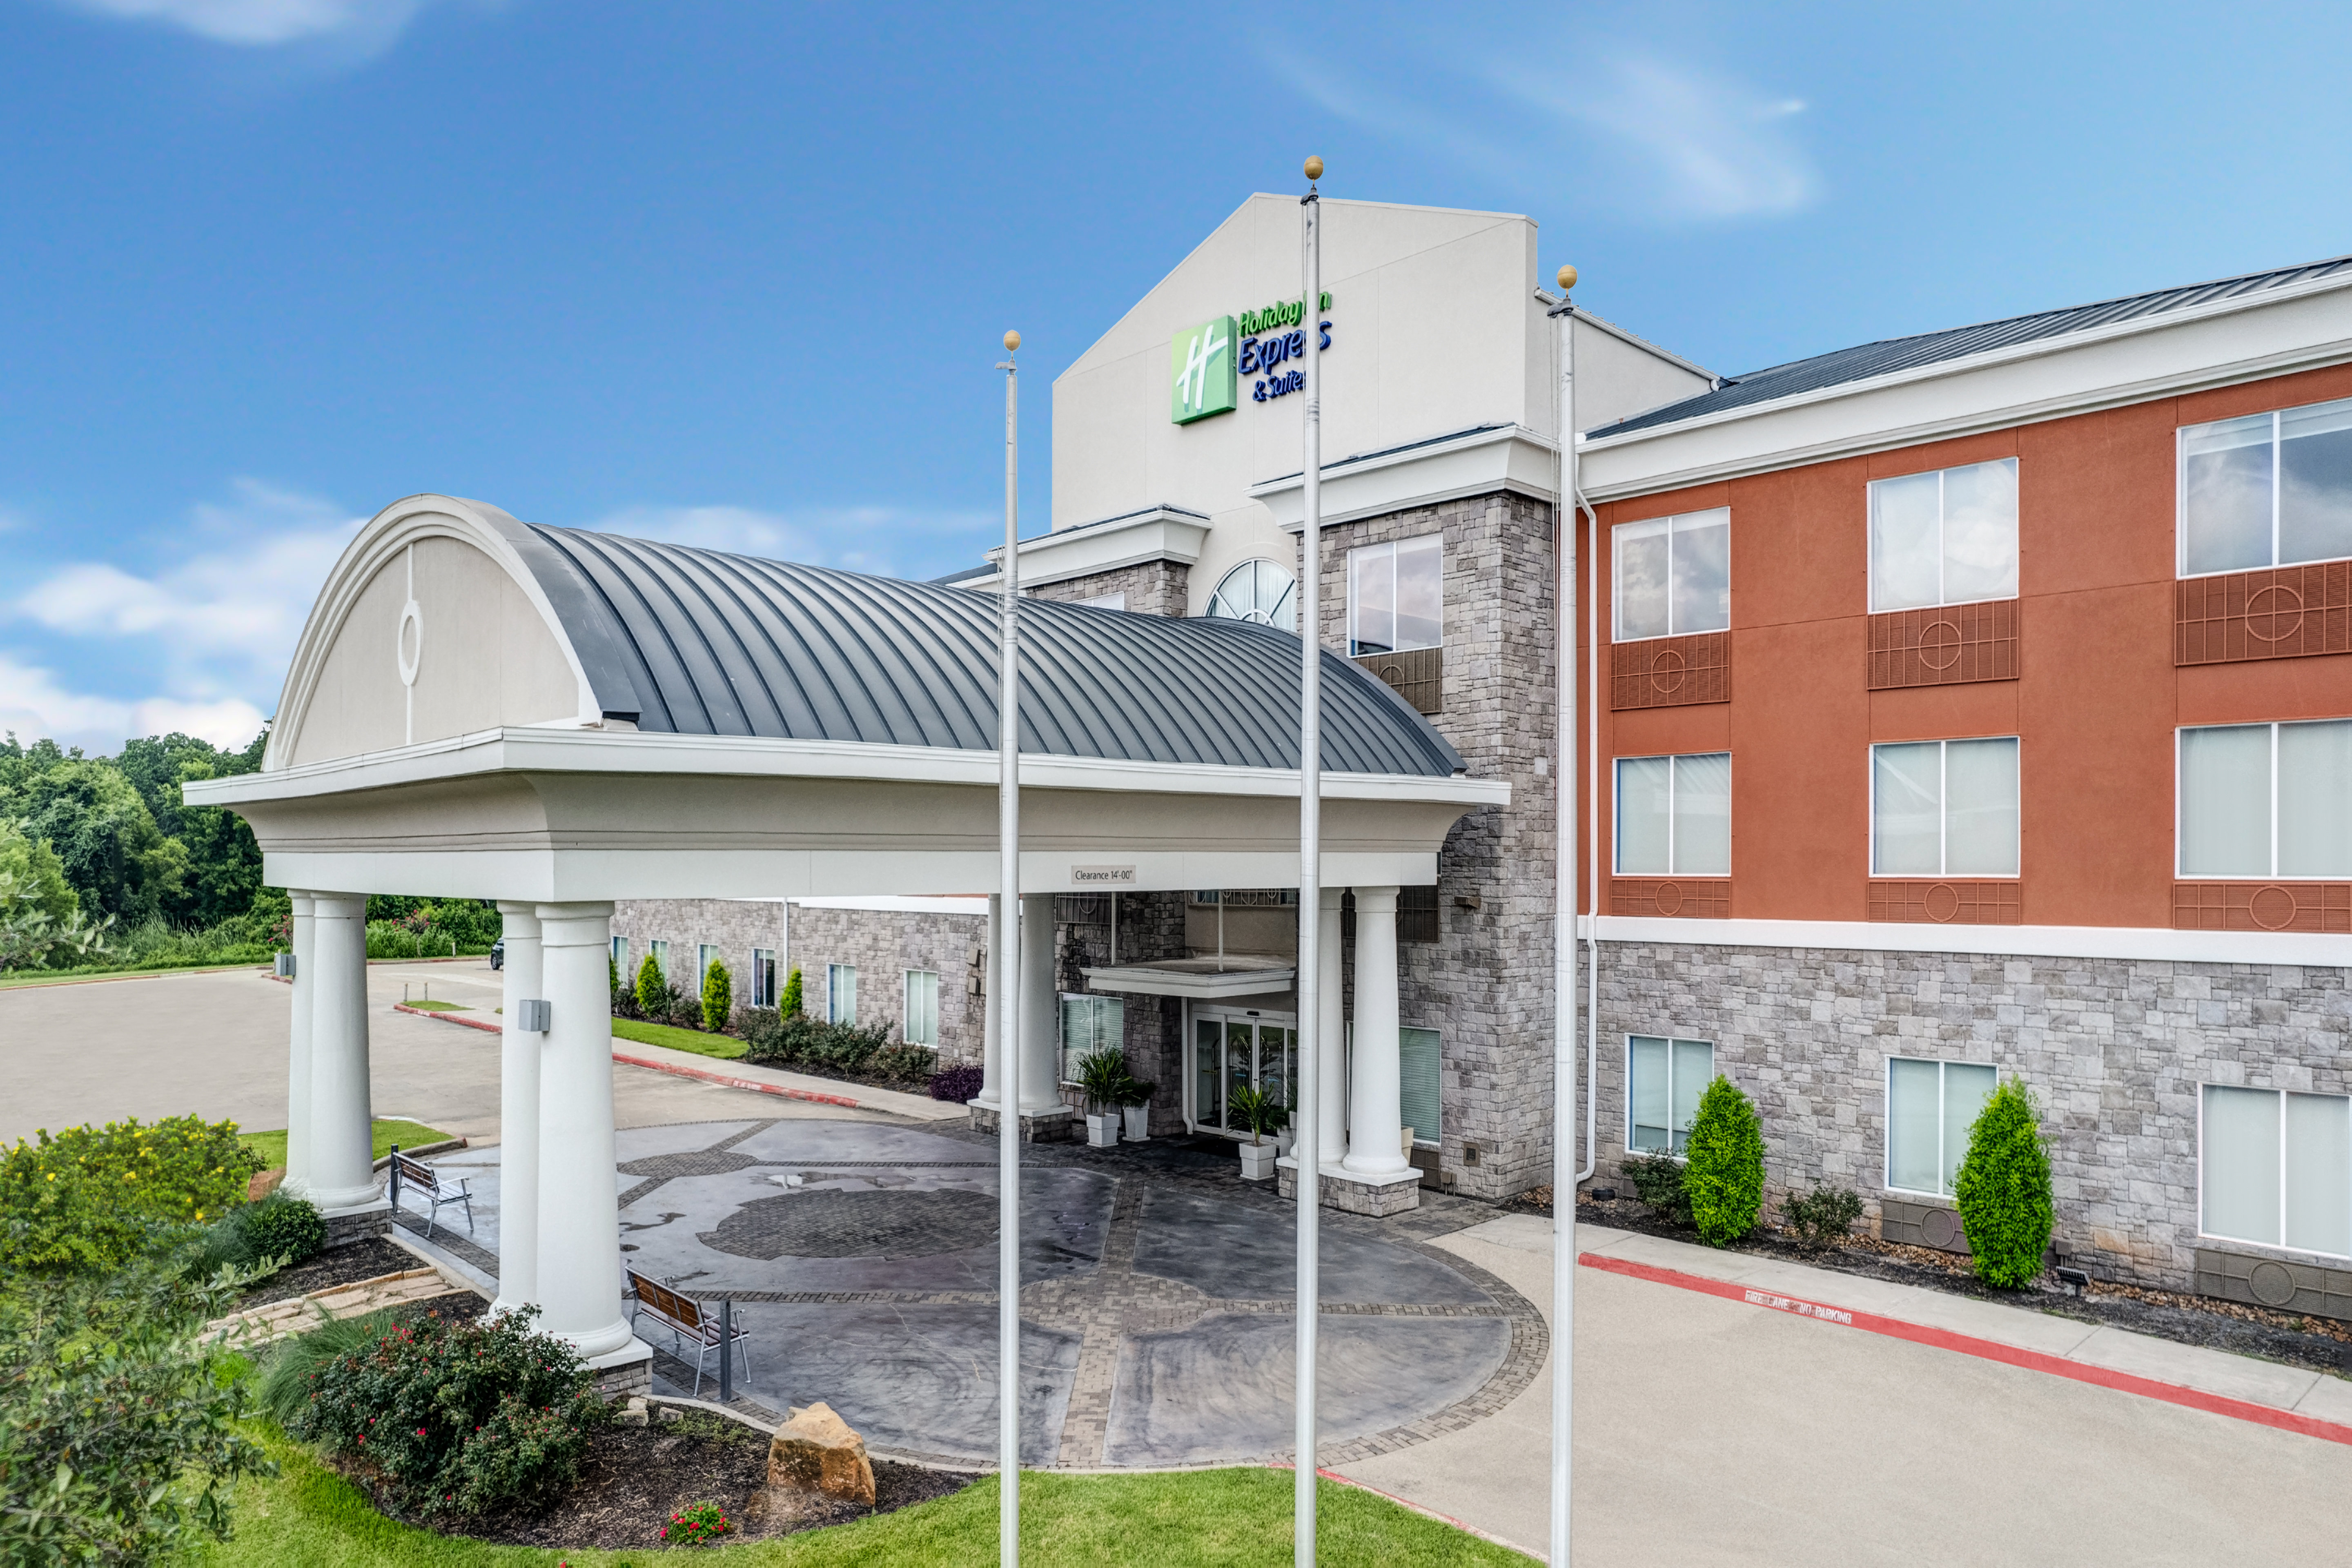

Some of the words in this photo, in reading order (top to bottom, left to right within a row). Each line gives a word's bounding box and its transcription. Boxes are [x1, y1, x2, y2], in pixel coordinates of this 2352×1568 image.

[1238, 301, 1303, 337] Holiday
[1302, 290, 1332, 316] In
[1238, 321, 1332, 375] Expres
[1252, 380, 1267, 402] &
[1075, 870, 1109, 880] Clearance
[1111, 870, 1132, 880] 14'-00"
[1745, 1290, 1764, 1303] FIRE
[1767, 1296, 1790, 1310] LANE
[1799, 1303, 1812, 1315] NO
[1815, 1305, 1852, 1324] PARKING
